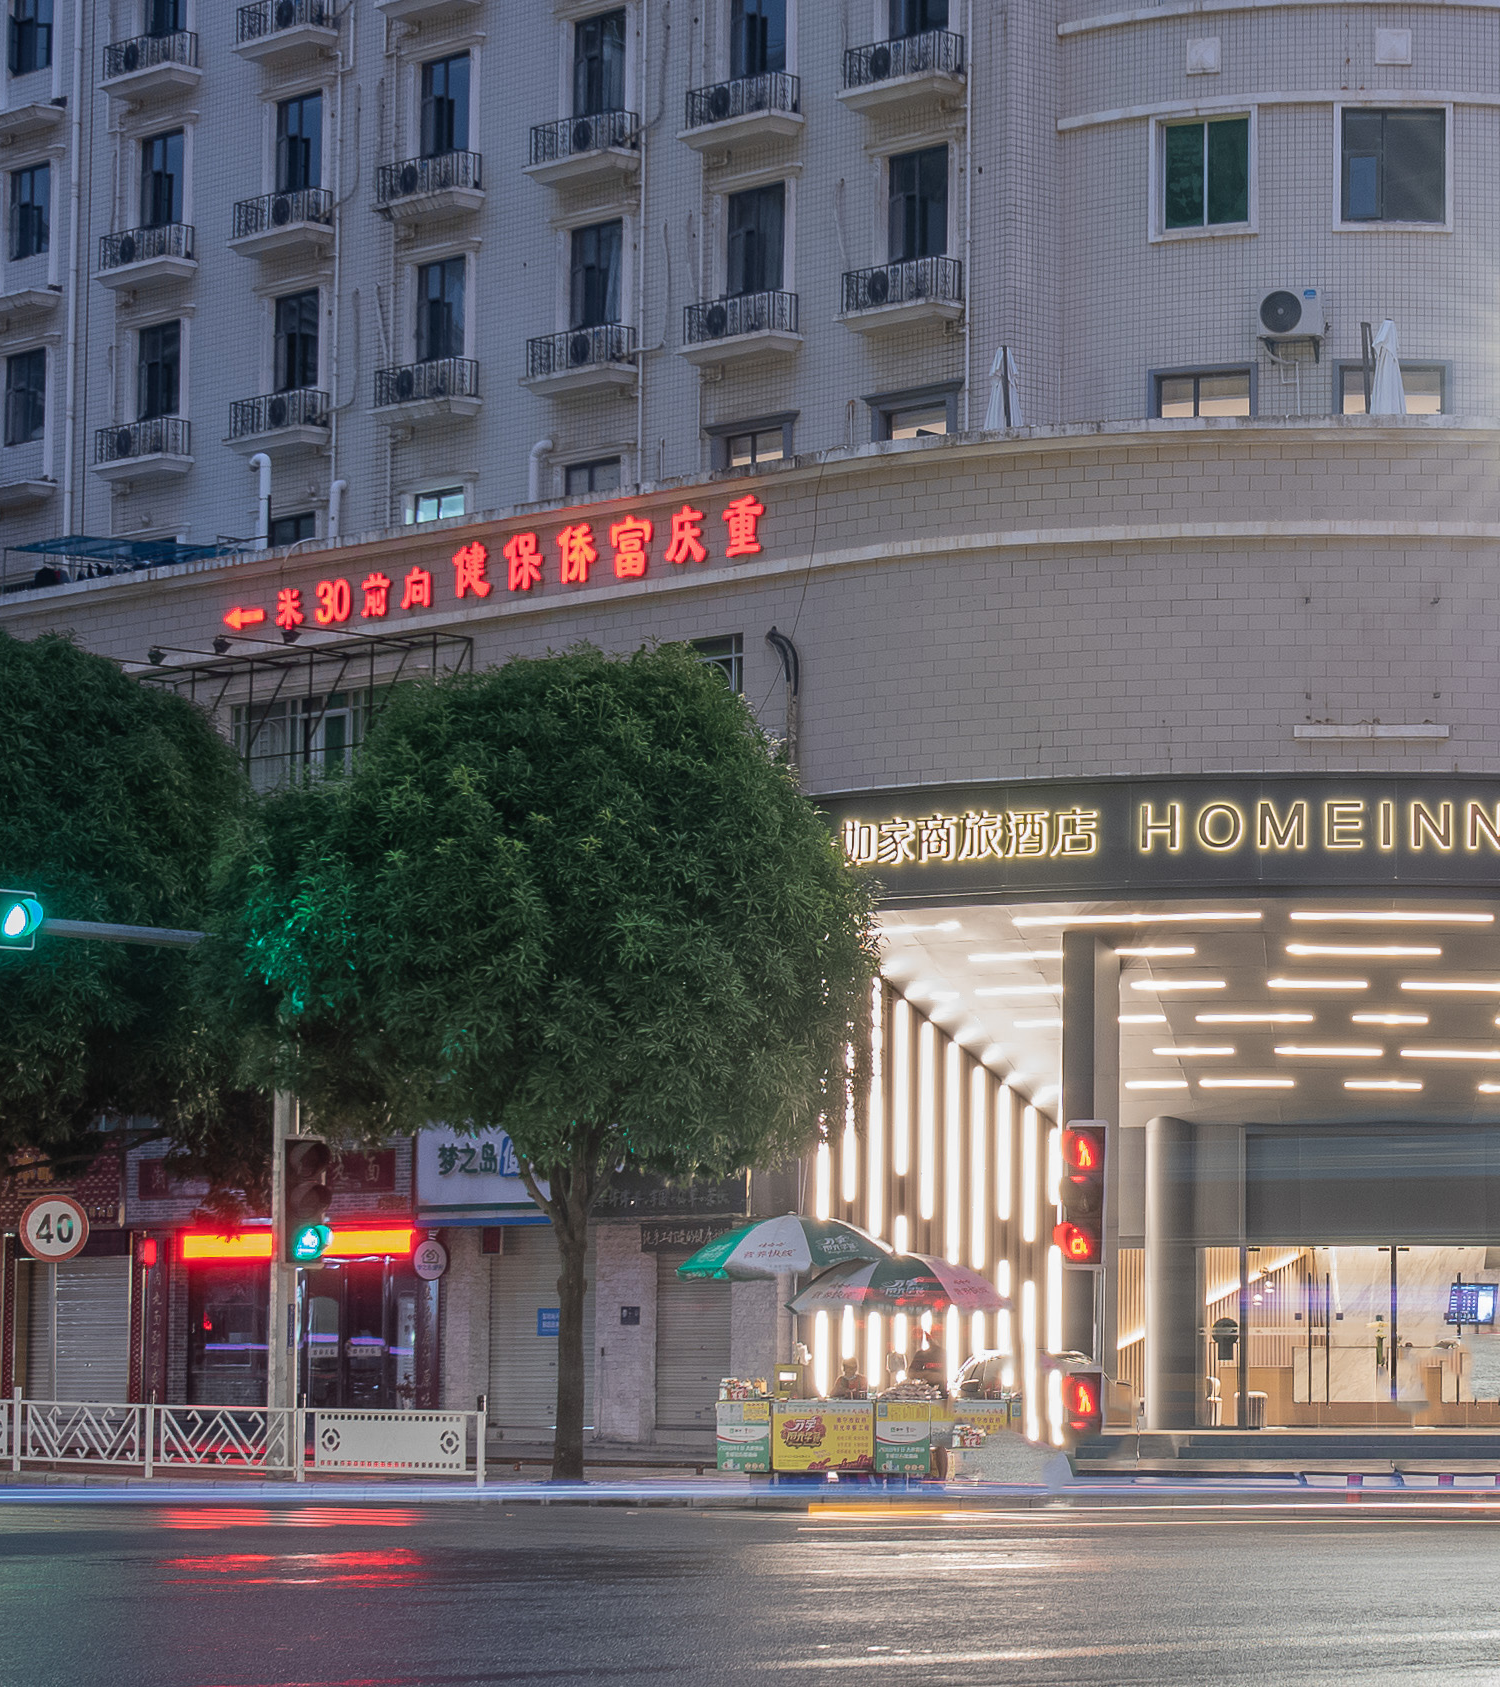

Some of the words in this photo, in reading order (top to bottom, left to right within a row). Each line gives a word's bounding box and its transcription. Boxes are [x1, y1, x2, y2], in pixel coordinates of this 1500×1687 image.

[842, 808, 1099, 865] 如家商旅酒店
[35, 1212, 74, 1244] 40
